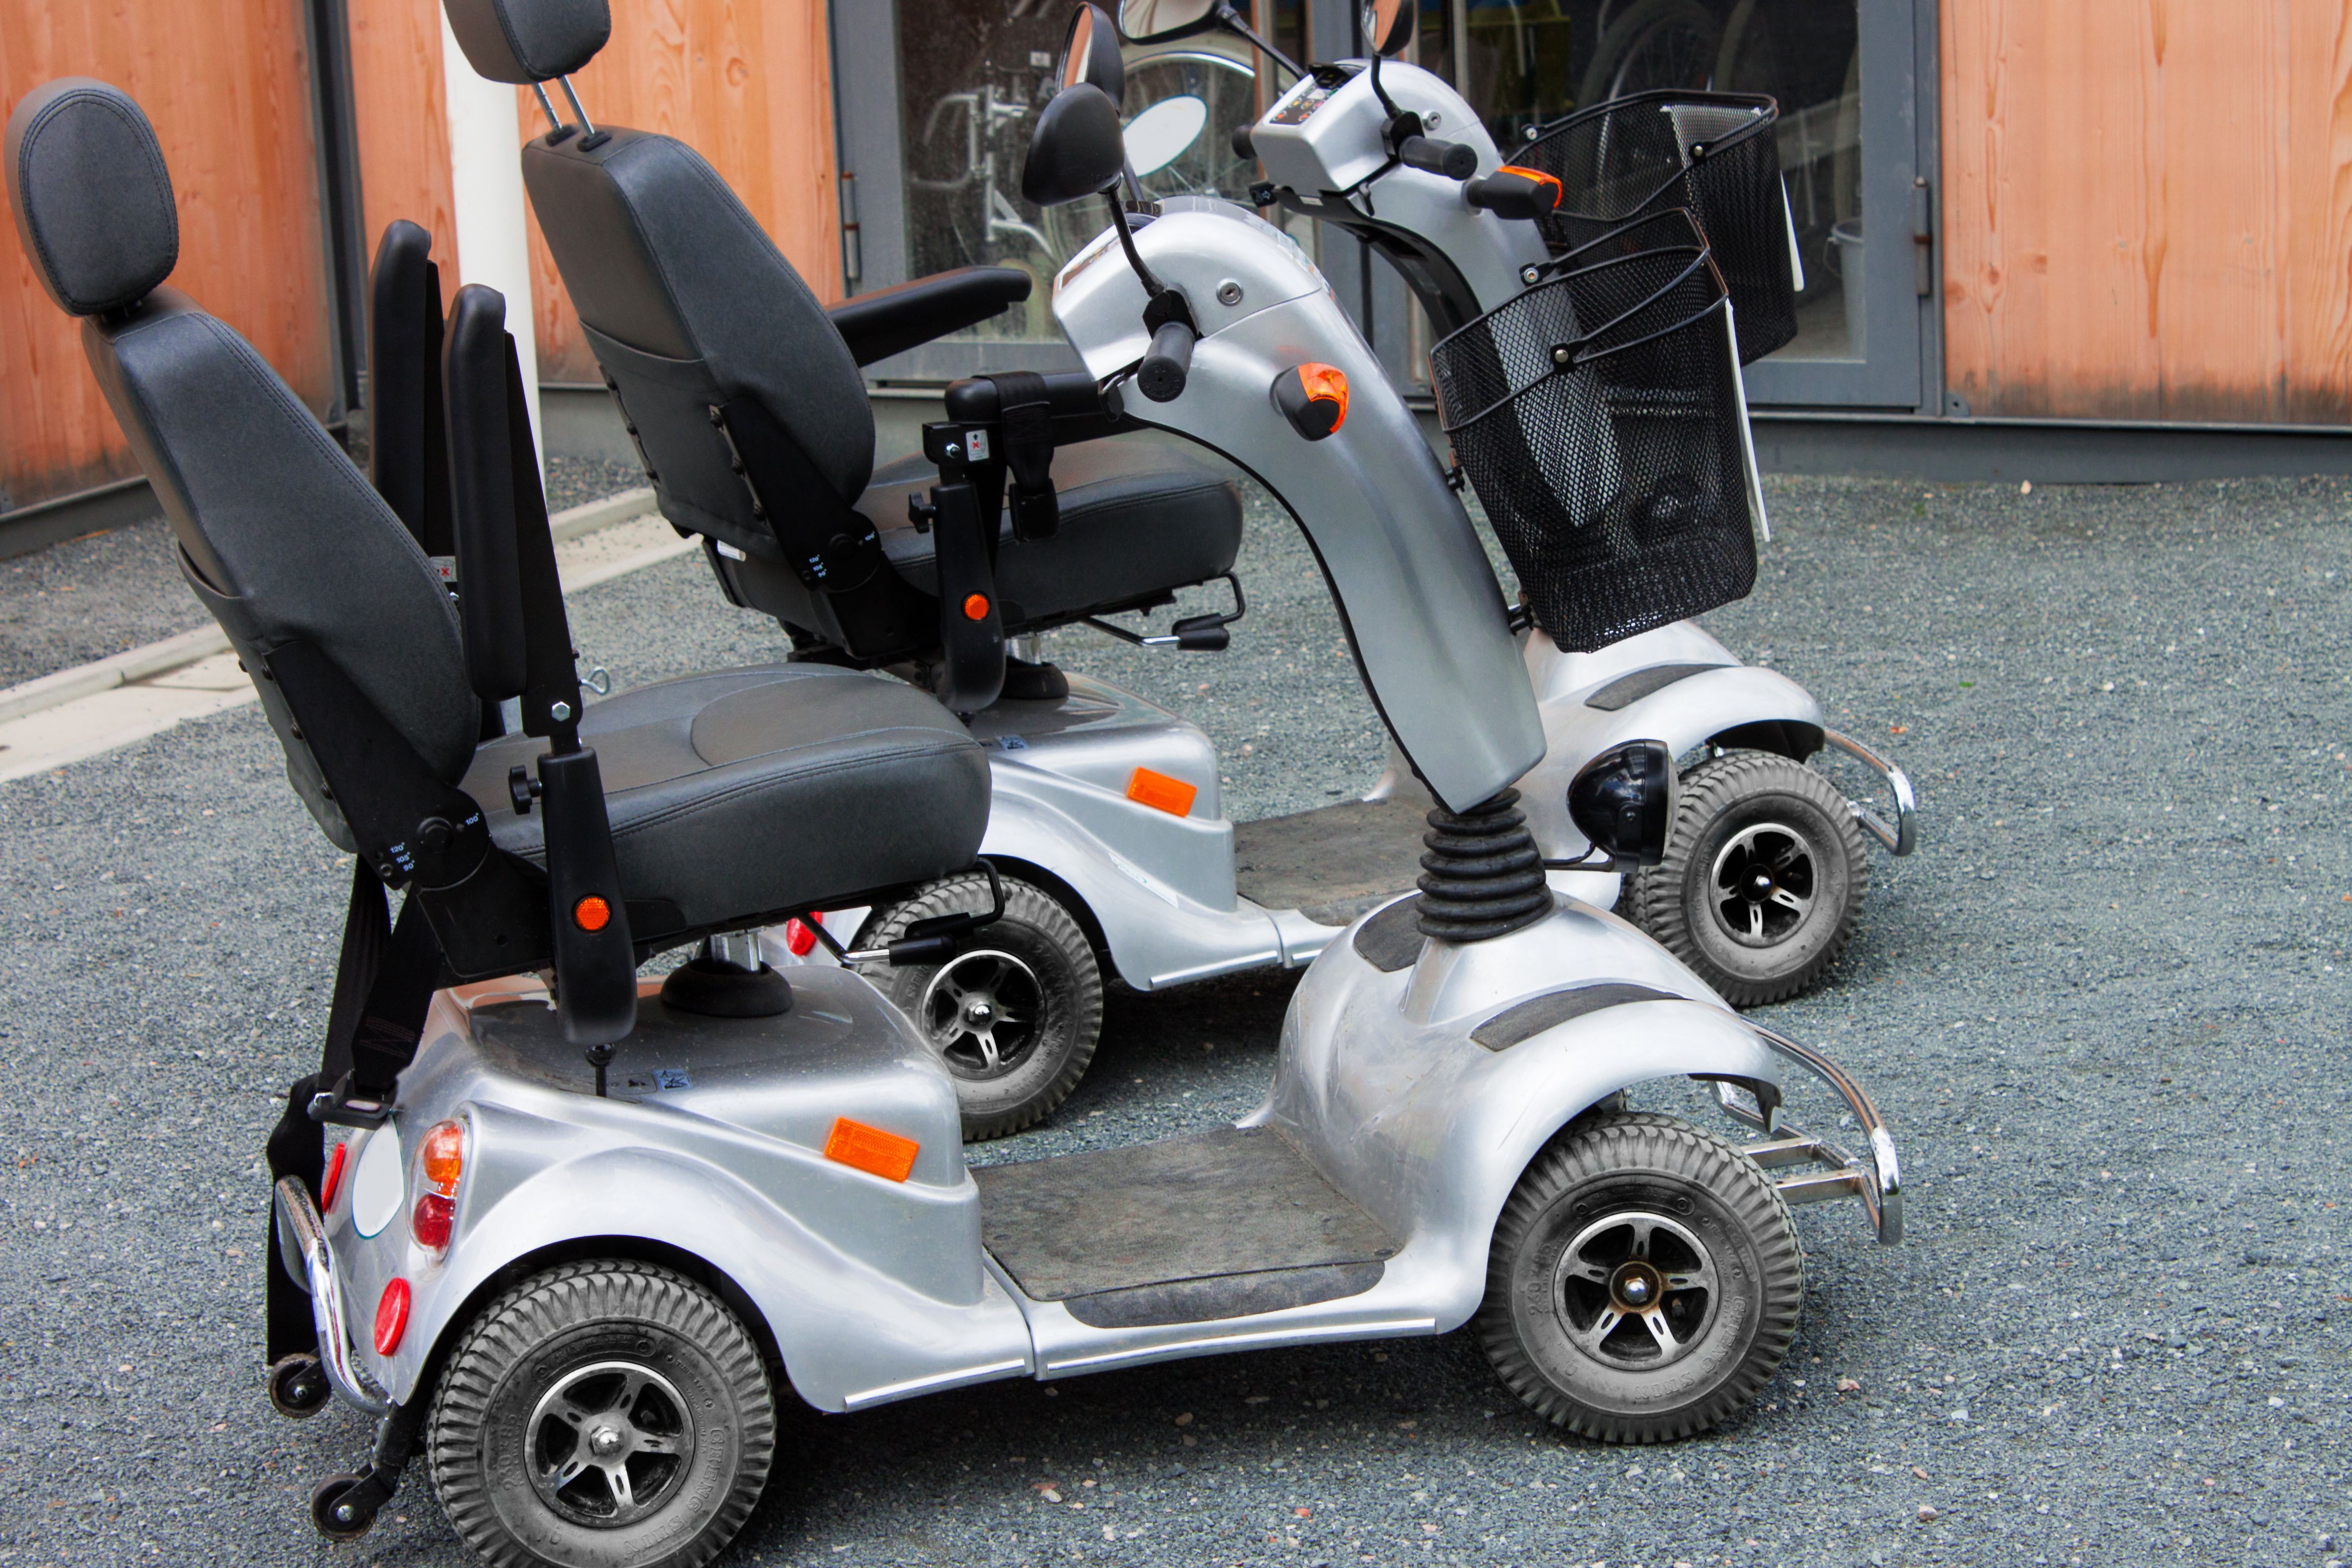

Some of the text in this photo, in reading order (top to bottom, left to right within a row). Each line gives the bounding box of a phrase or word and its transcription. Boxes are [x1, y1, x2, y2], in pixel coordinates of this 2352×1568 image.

[1634, 1296, 1747, 1399] CHENG SHIN
[623, 1426, 725, 1555] CHENG SHIN
